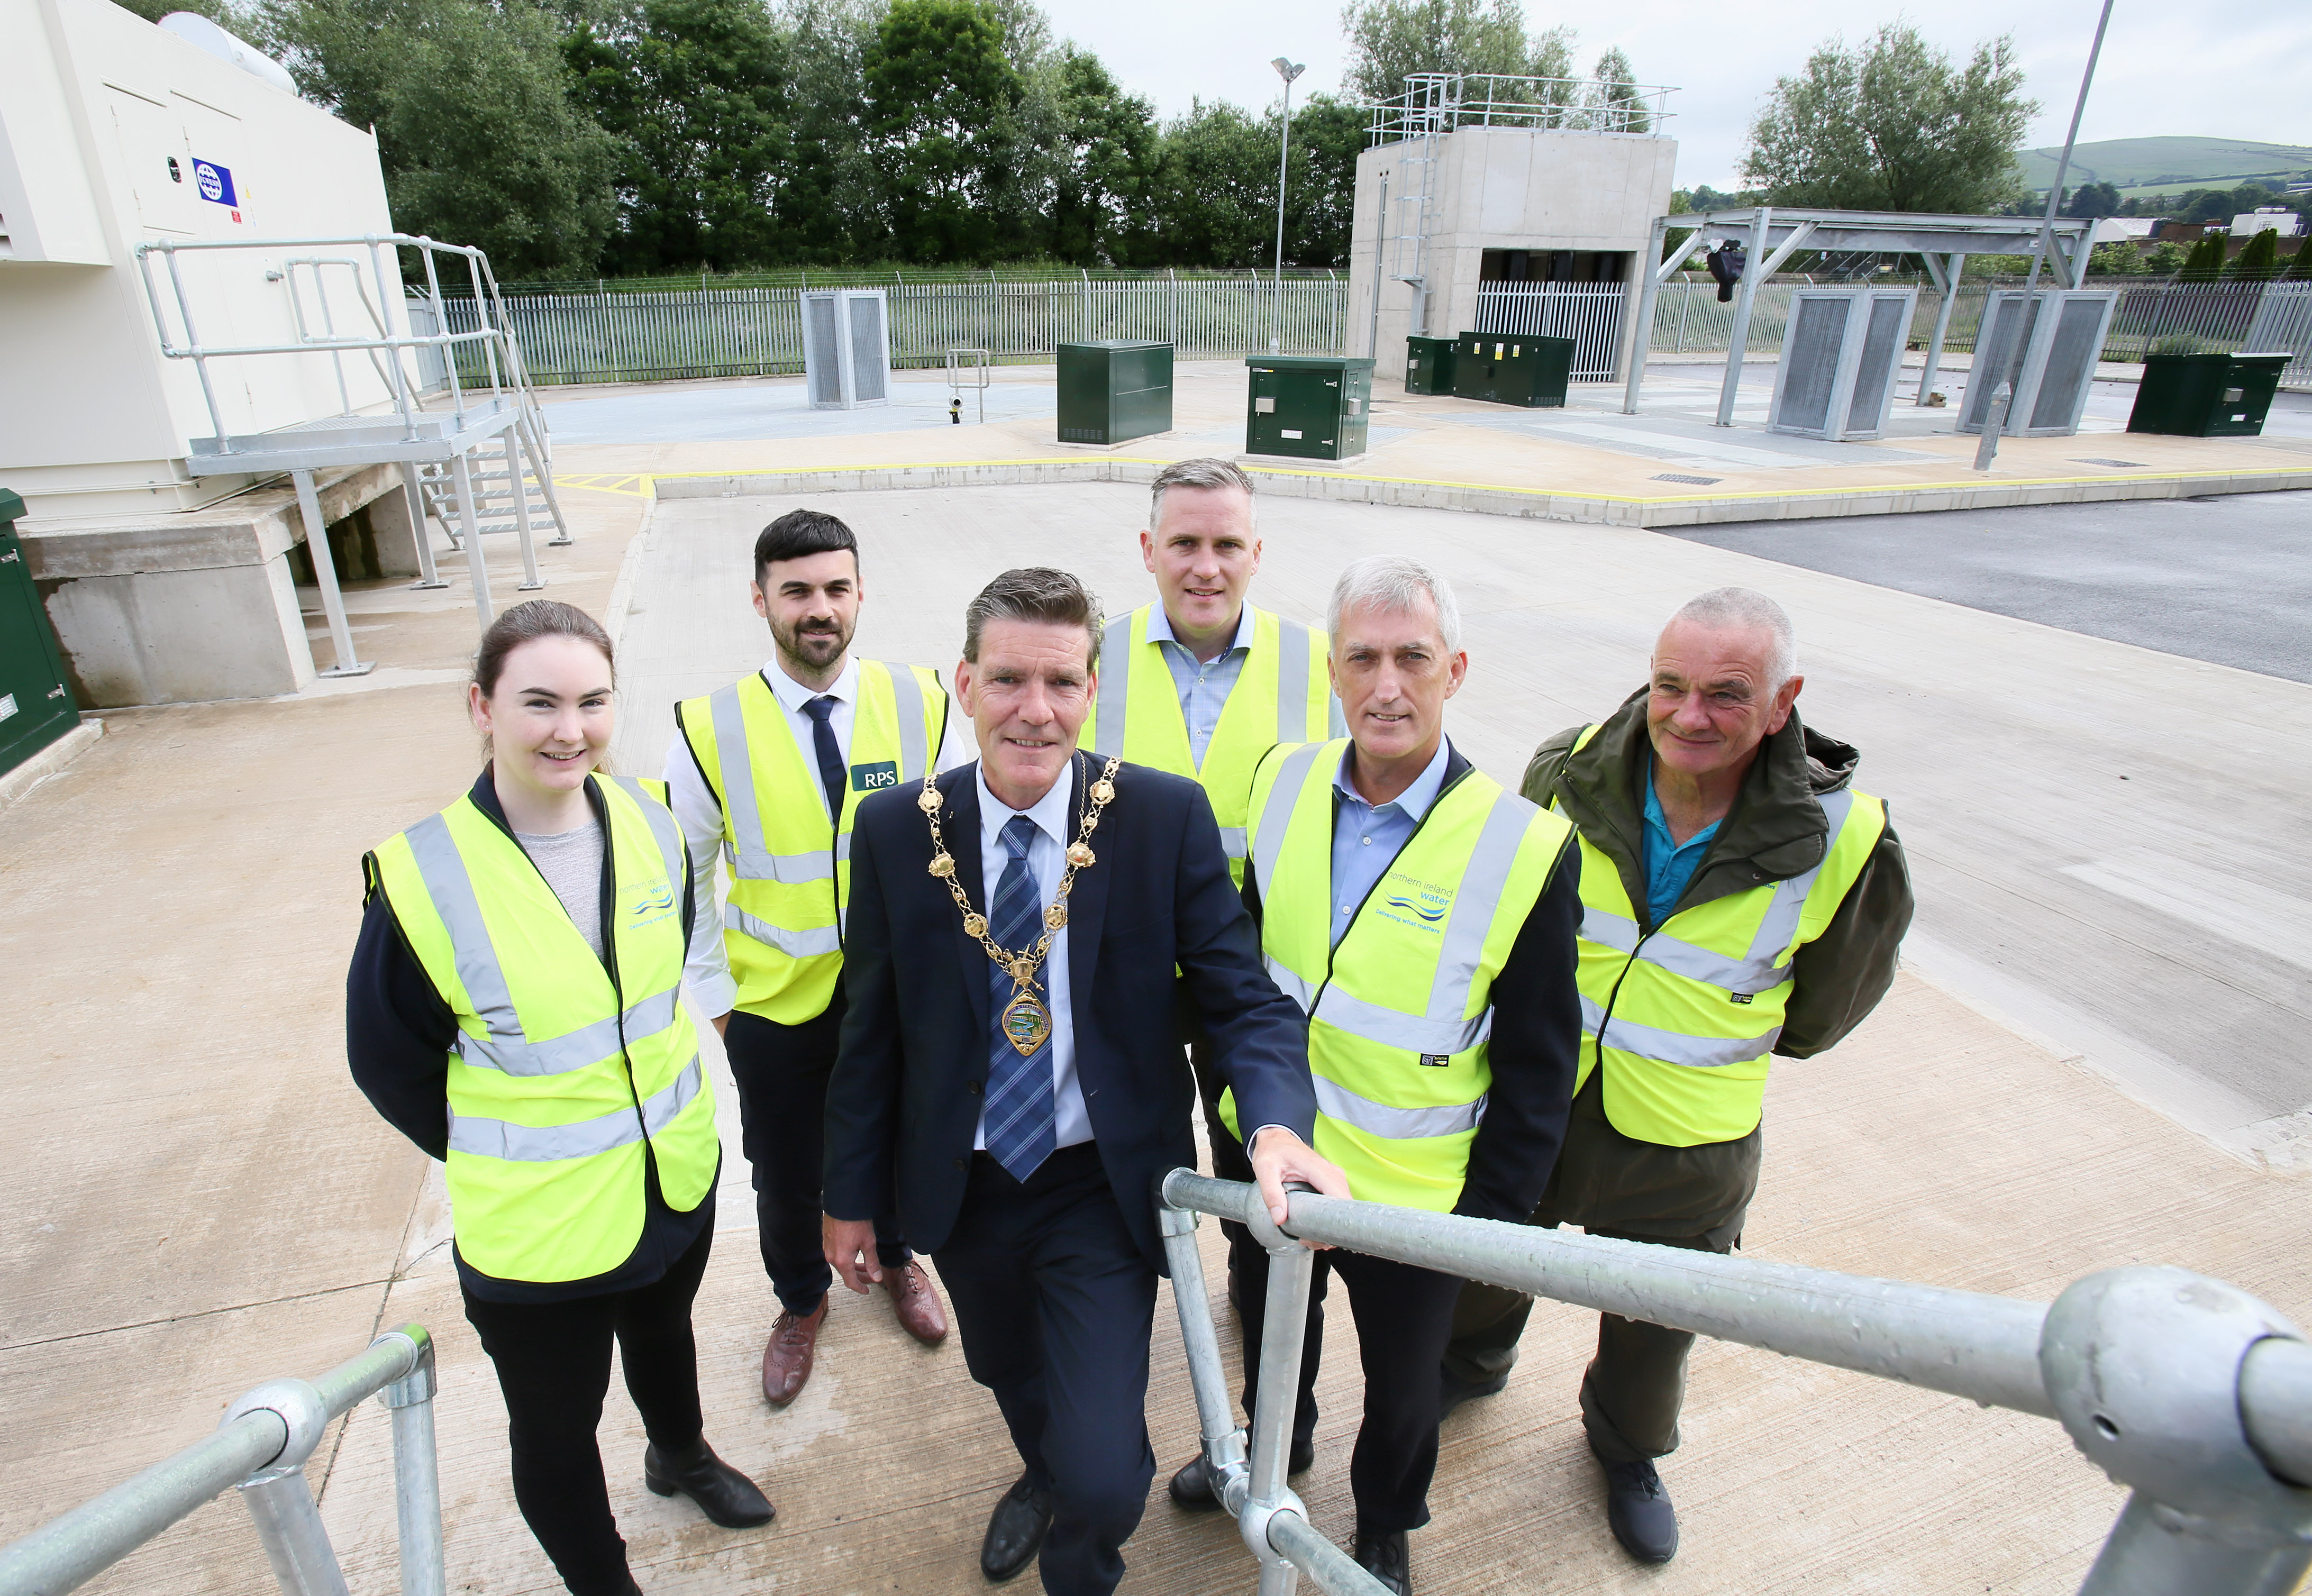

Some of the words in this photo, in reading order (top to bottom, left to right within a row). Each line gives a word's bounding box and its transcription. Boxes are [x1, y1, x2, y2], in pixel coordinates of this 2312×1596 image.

[864, 771, 895, 788] RPS
[619, 882, 647, 895] northern
[1388, 871, 1422, 888] northern
[1424, 881, 1453, 897] ireland
[1421, 891, 1450, 906] water
[629, 919, 653, 930] Delivering
[1376, 909, 1401, 922] Delivering
[1418, 924, 1440, 934] matters
